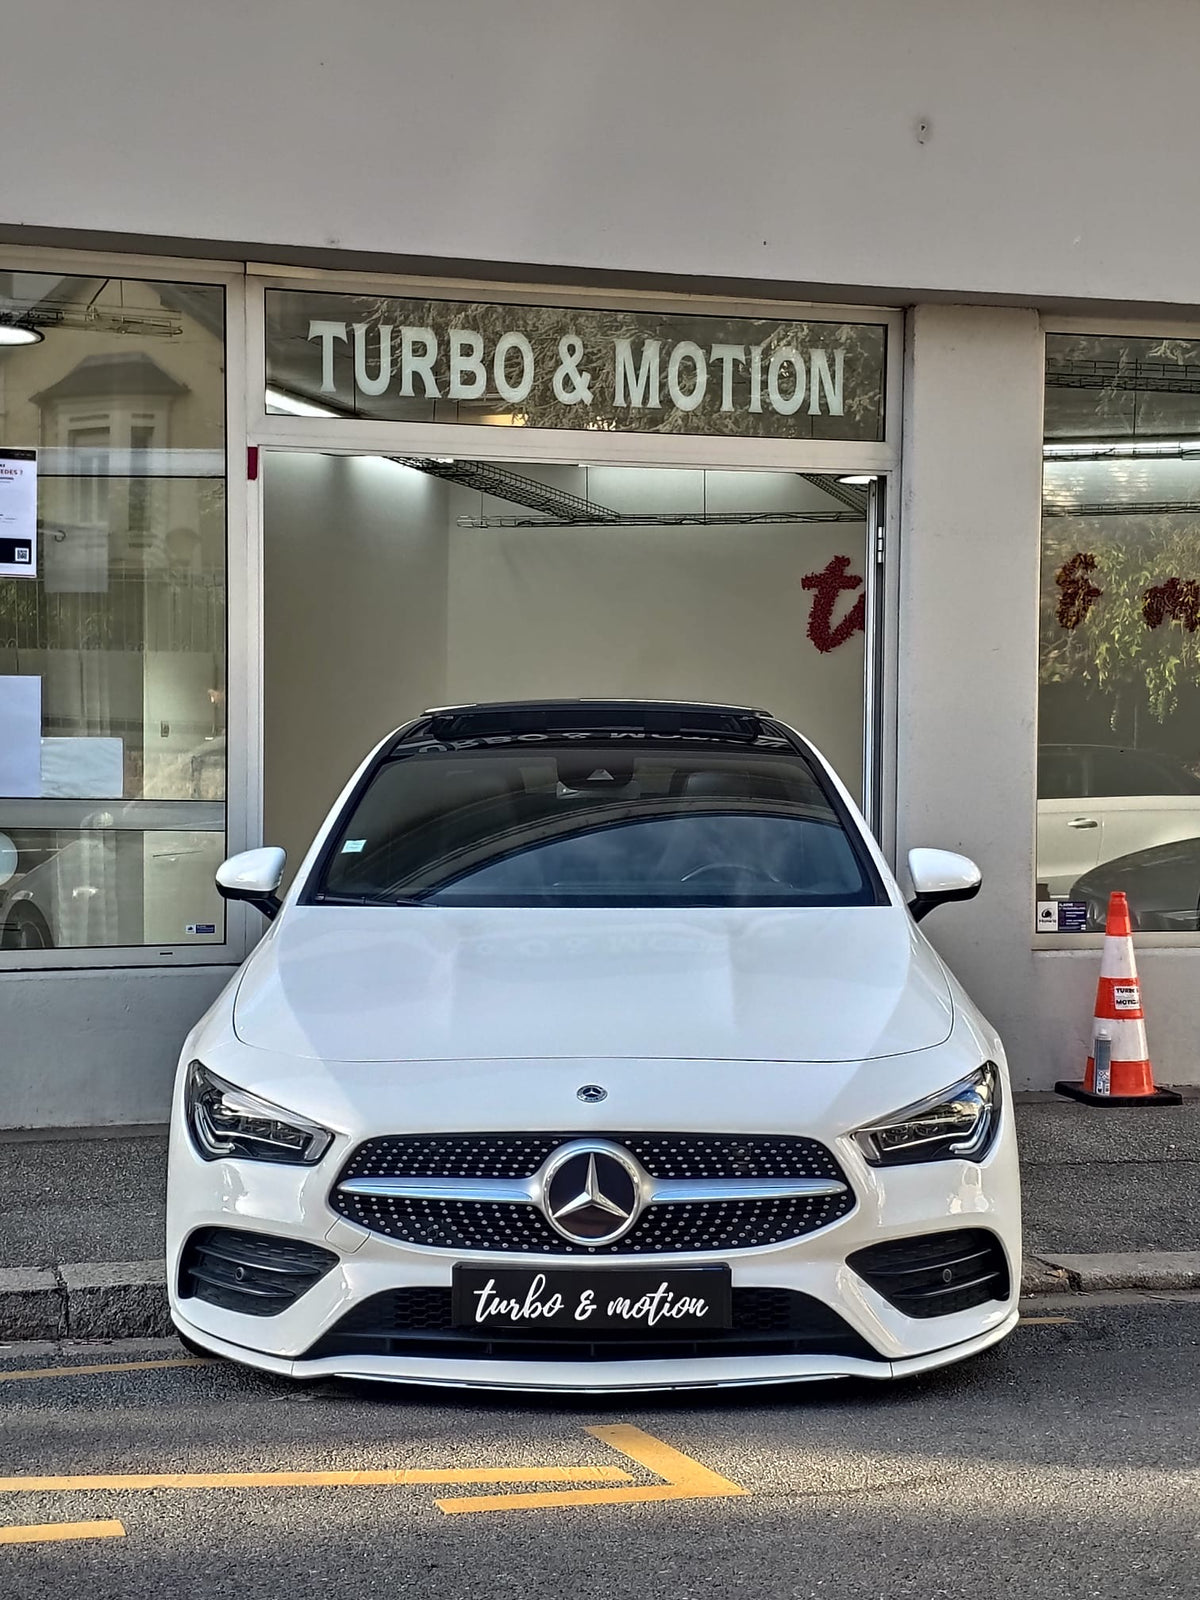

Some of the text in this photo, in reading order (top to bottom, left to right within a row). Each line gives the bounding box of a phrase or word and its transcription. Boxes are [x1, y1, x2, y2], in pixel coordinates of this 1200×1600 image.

[307, 320, 845, 418] TURBO & MOTION
[473, 1273, 709, 1326] turbo & motion
